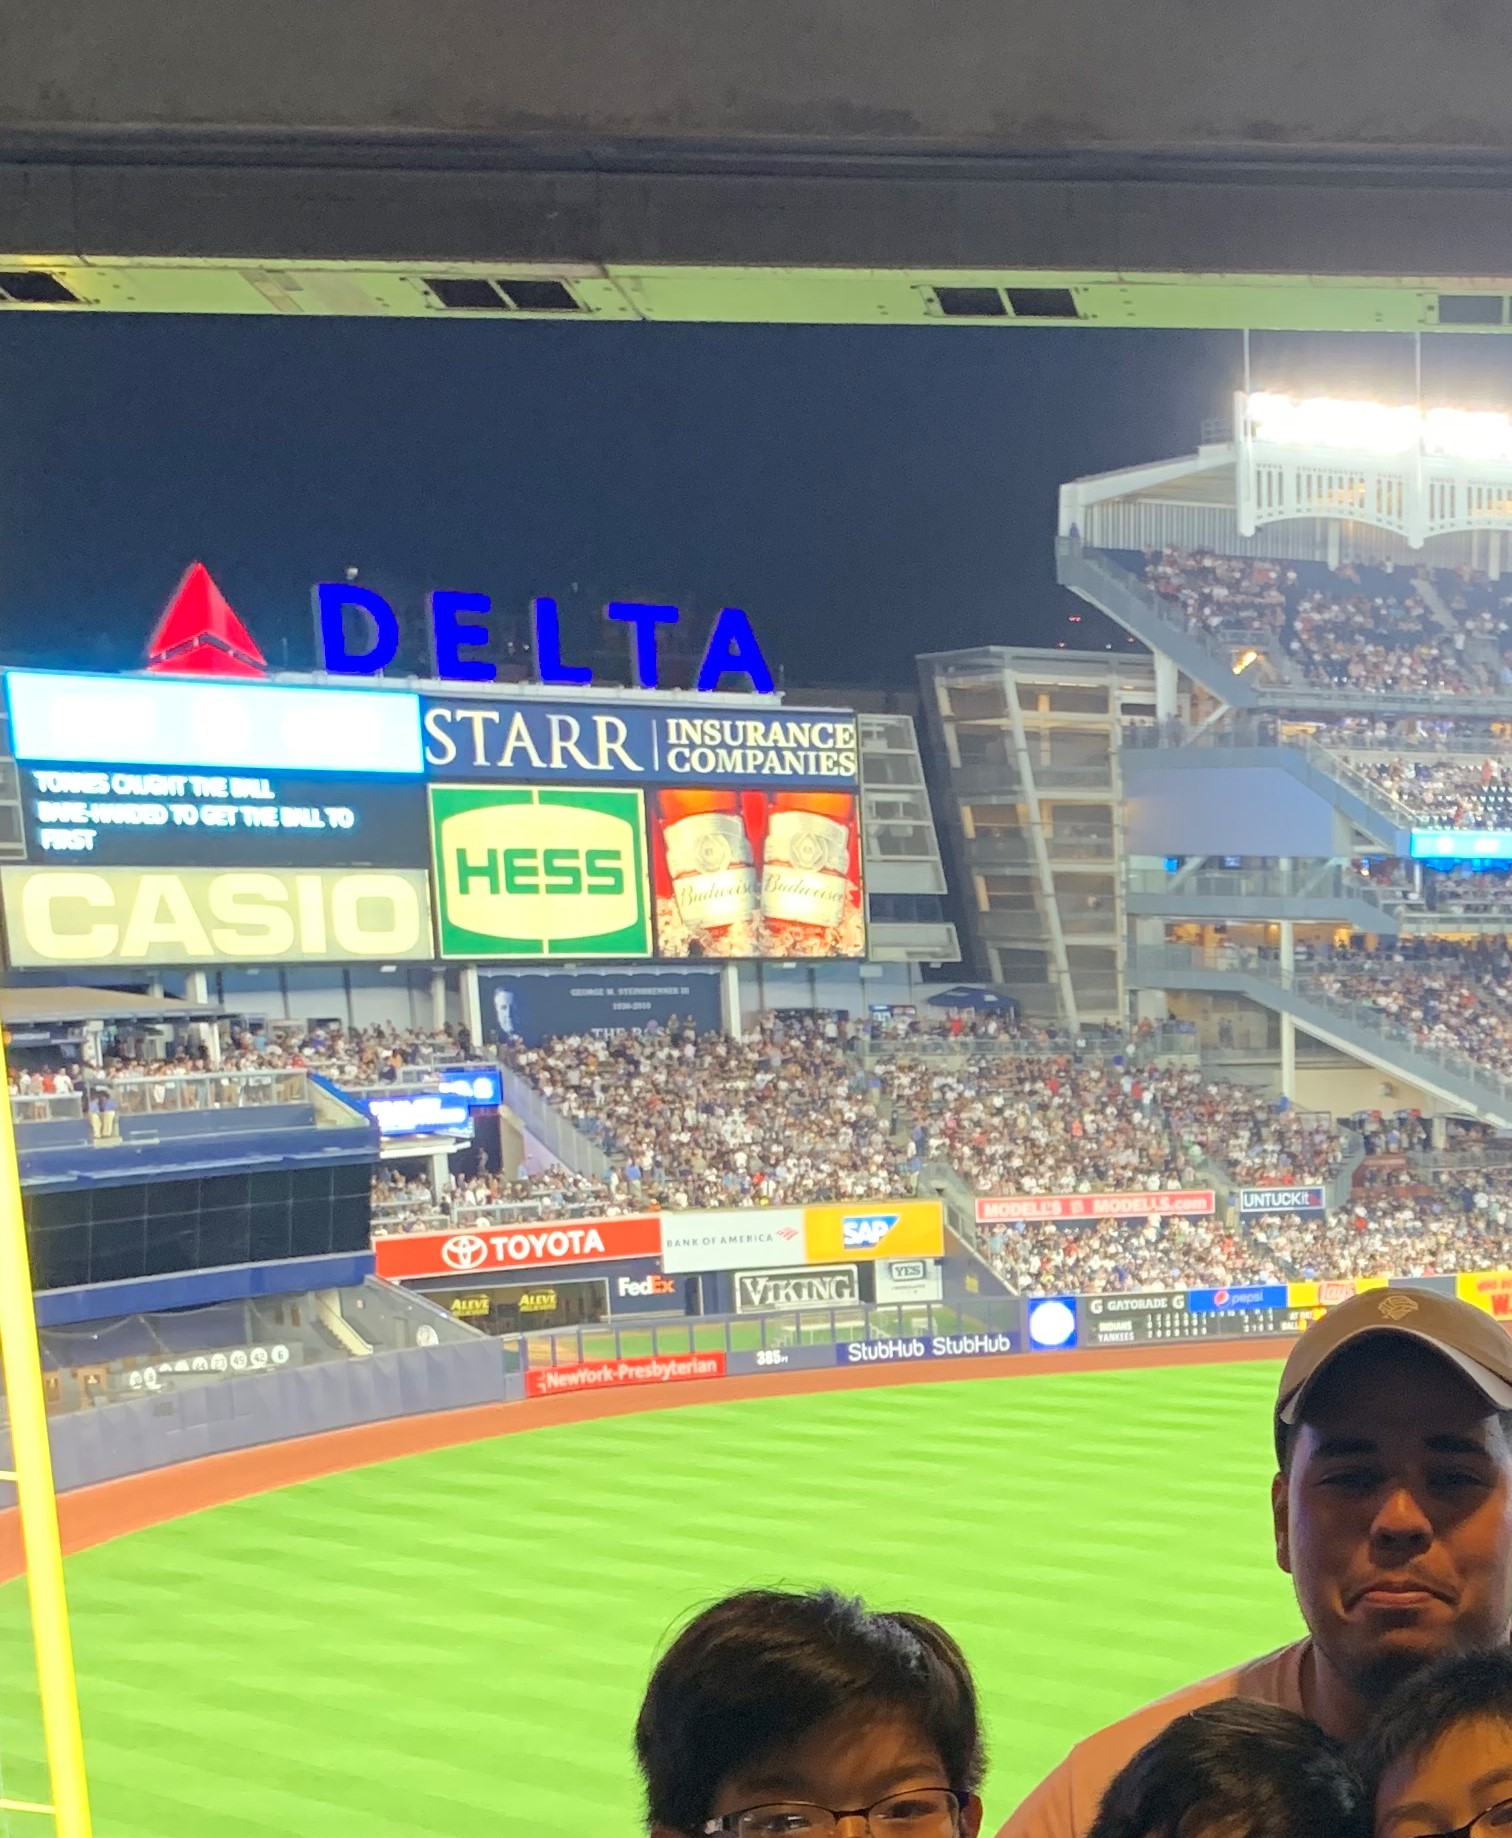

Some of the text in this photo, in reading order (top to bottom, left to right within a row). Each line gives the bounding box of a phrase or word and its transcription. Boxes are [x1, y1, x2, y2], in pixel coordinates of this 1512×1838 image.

[313, 583, 775, 694] DELTA
[424, 708, 644, 773] STARR
[666, 718, 856, 750] INSURANCE
[666, 748, 857, 777] COMPANIES
[111, 773, 189, 797] CAUGHT
[188, 776, 229, 798] THE
[169, 804, 199, 826] TO
[200, 804, 239, 827] GET
[239, 806, 280, 828] THE
[325, 807, 354, 829] TO
[40, 829, 97, 851] FIRST
[456, 848, 626, 896] HESS
[22, 872, 421, 960] CASIO
[984, 1200, 1062, 1217] MODELL'S
[1244, 1191, 1309, 1207] UNTUCKit
[490, 1229, 605, 1261] TOYOTA
[667, 1233, 773, 1248] BANK OF AMERICA
[844, 1220, 890, 1245] SAP
[895, 1265, 921, 1277] YES
[618, 1275, 675, 1297] FedEx
[742, 1275, 851, 1306] VIKING
[1231, 1291, 1264, 1306] pepsi
[1108, 1298, 1168, 1312] GATORADE
[848, 1333, 1011, 1361] StubHub StubHub
[1098, 1331, 1134, 1342] YANKEES
